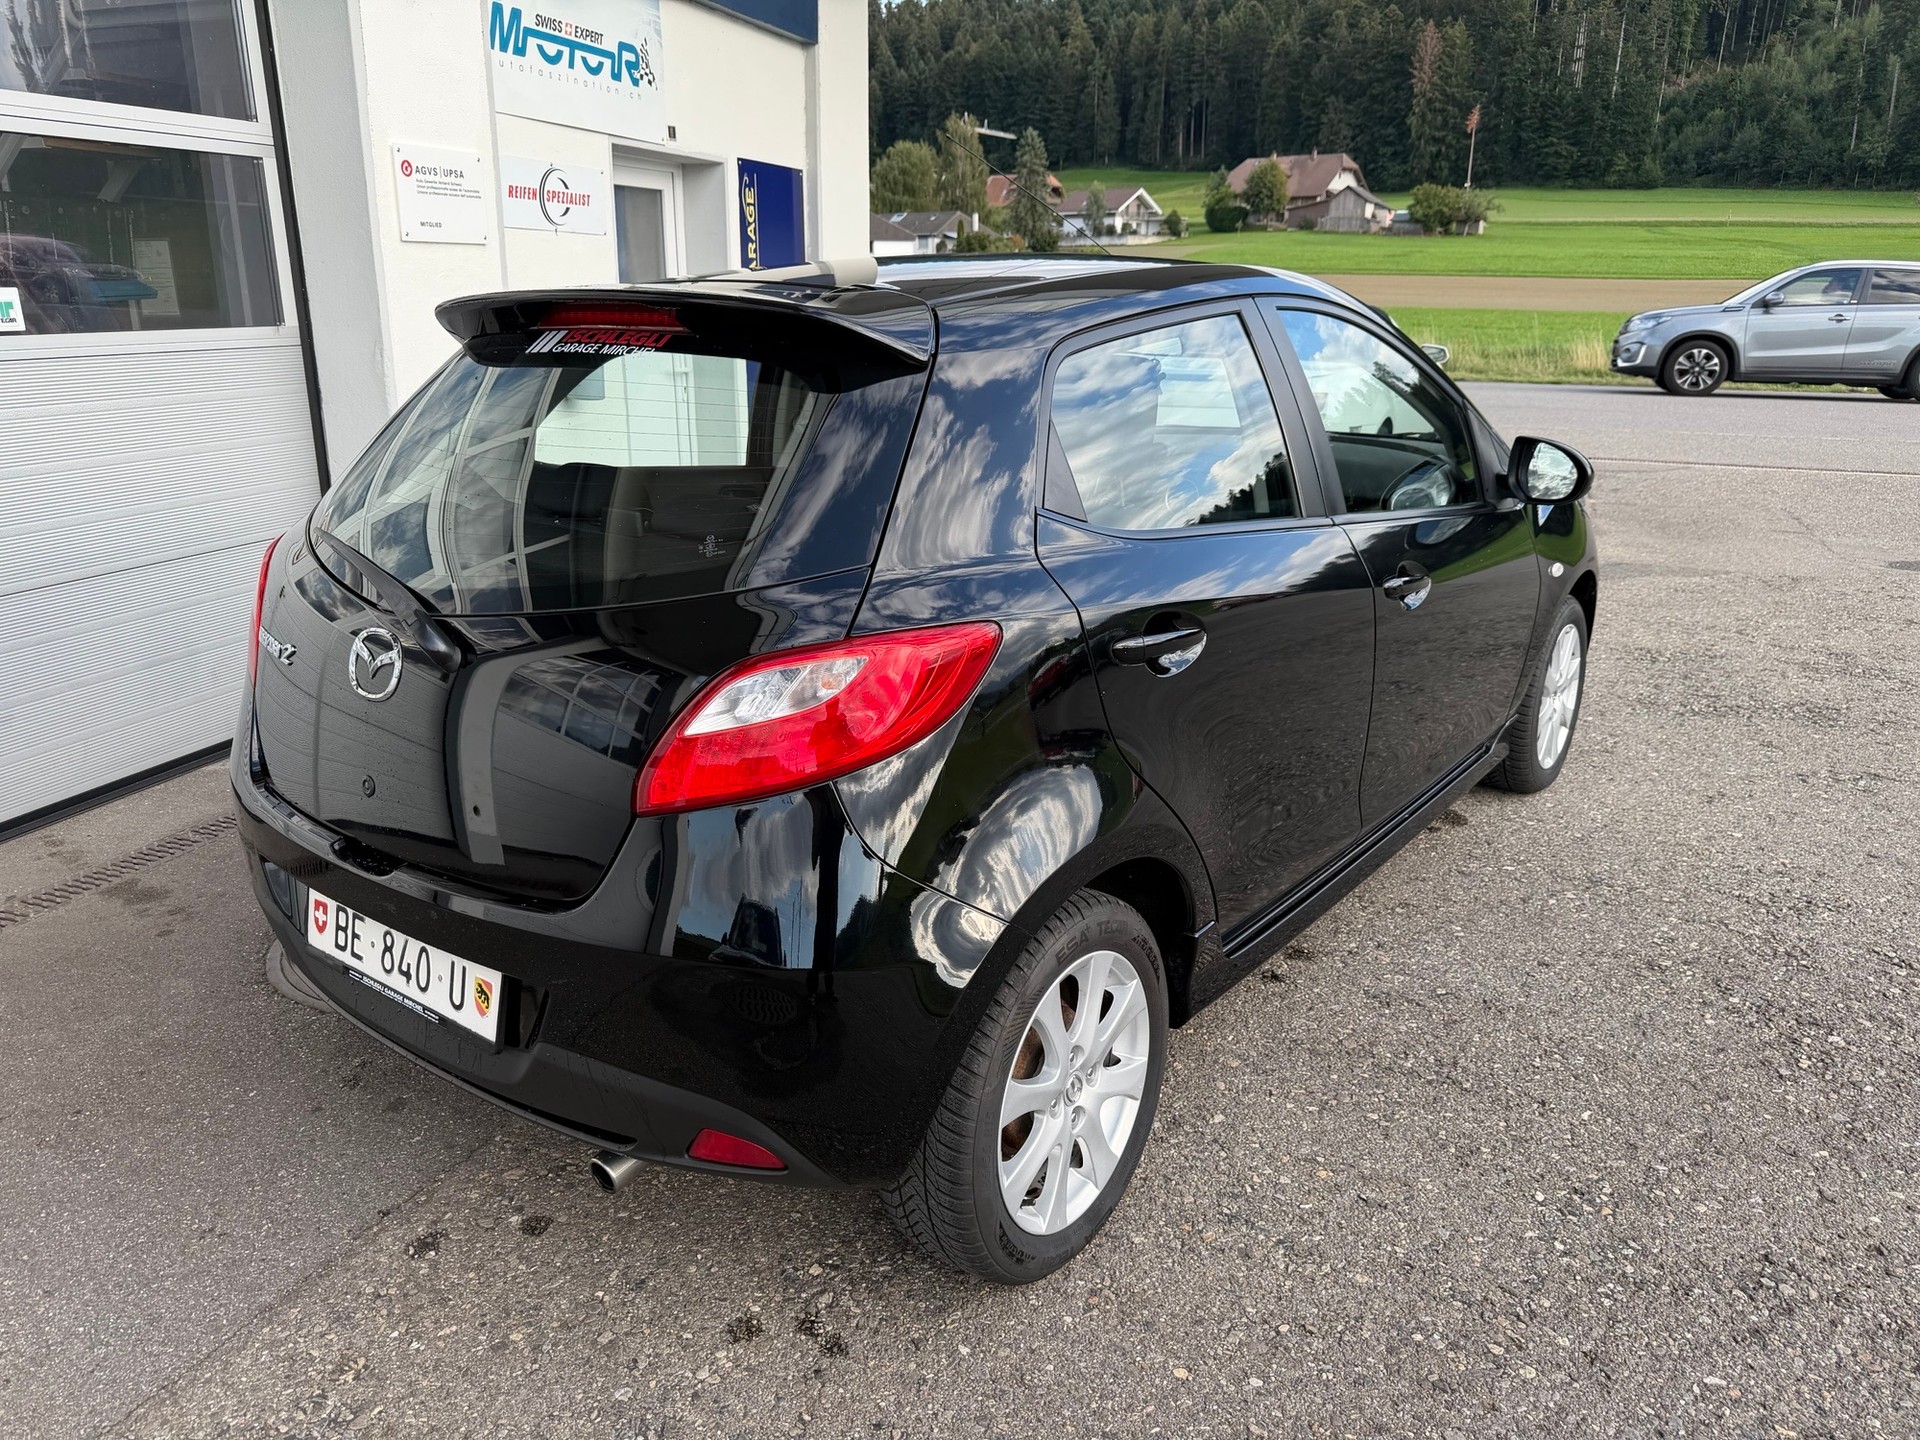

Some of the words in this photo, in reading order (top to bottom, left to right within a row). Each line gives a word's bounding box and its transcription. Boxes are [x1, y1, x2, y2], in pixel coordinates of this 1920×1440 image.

[535, 13, 563, 34] SWISS
[574, 25, 604, 46] EXPERT
[415, 165, 438, 177] AGVS
[443, 168, 465, 179] UPSA
[508, 184, 538, 201] REIFEN
[546, 189, 591, 207] SPEZIALIST
[552, 343, 602, 354] GARAGE
[334, 903, 367, 964] BE
[380, 929, 431, 993] 840
[449, 959, 467, 1011] U
